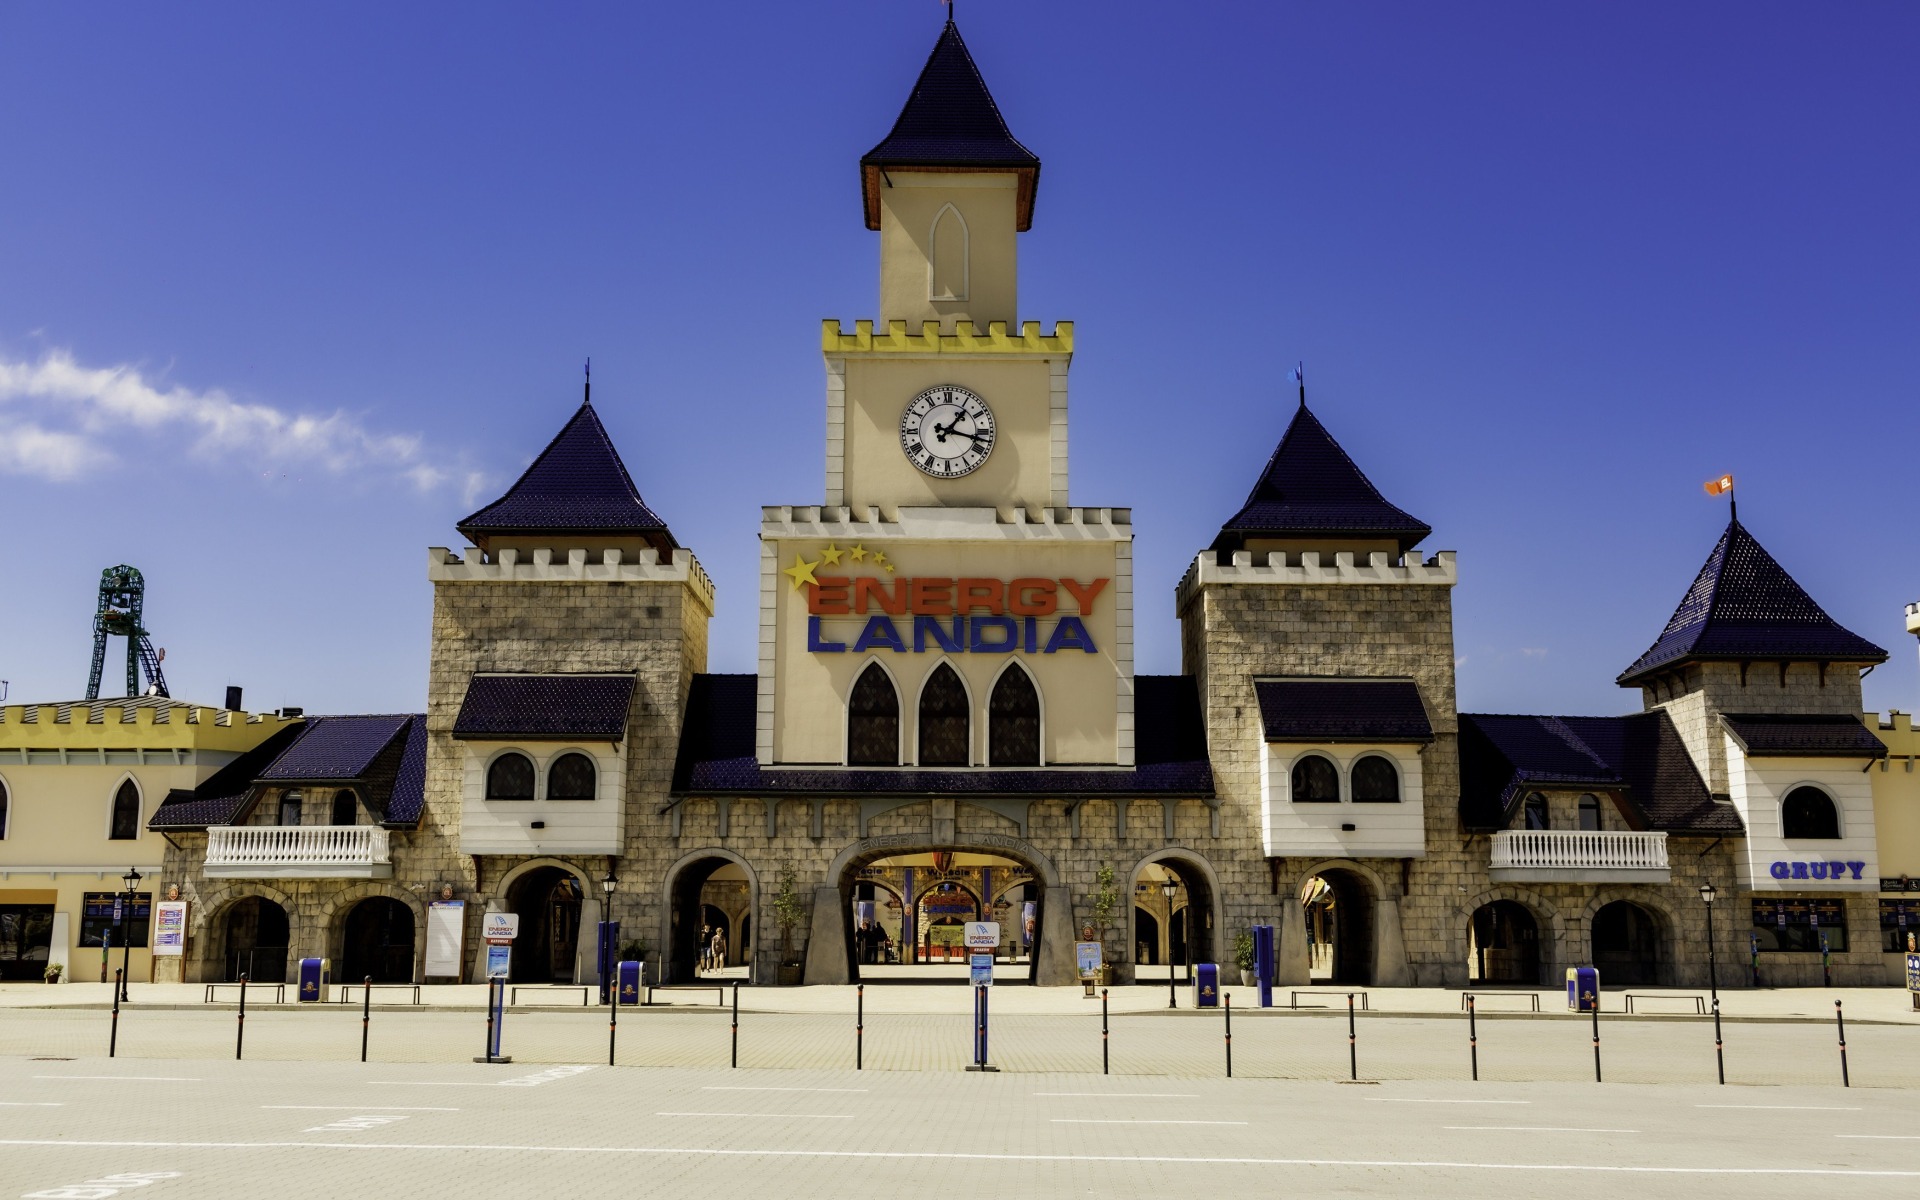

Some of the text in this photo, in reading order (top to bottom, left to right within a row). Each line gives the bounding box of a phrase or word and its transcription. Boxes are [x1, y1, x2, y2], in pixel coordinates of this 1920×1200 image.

[808, 577, 1110, 616] ENERGY
[807, 615, 1099, 653] LANDIA
[859, 834, 1030, 855] ENERGY LANDIA
[1770, 861, 1866, 880] GRUPY
[20, 1171, 182, 1199] BUS
